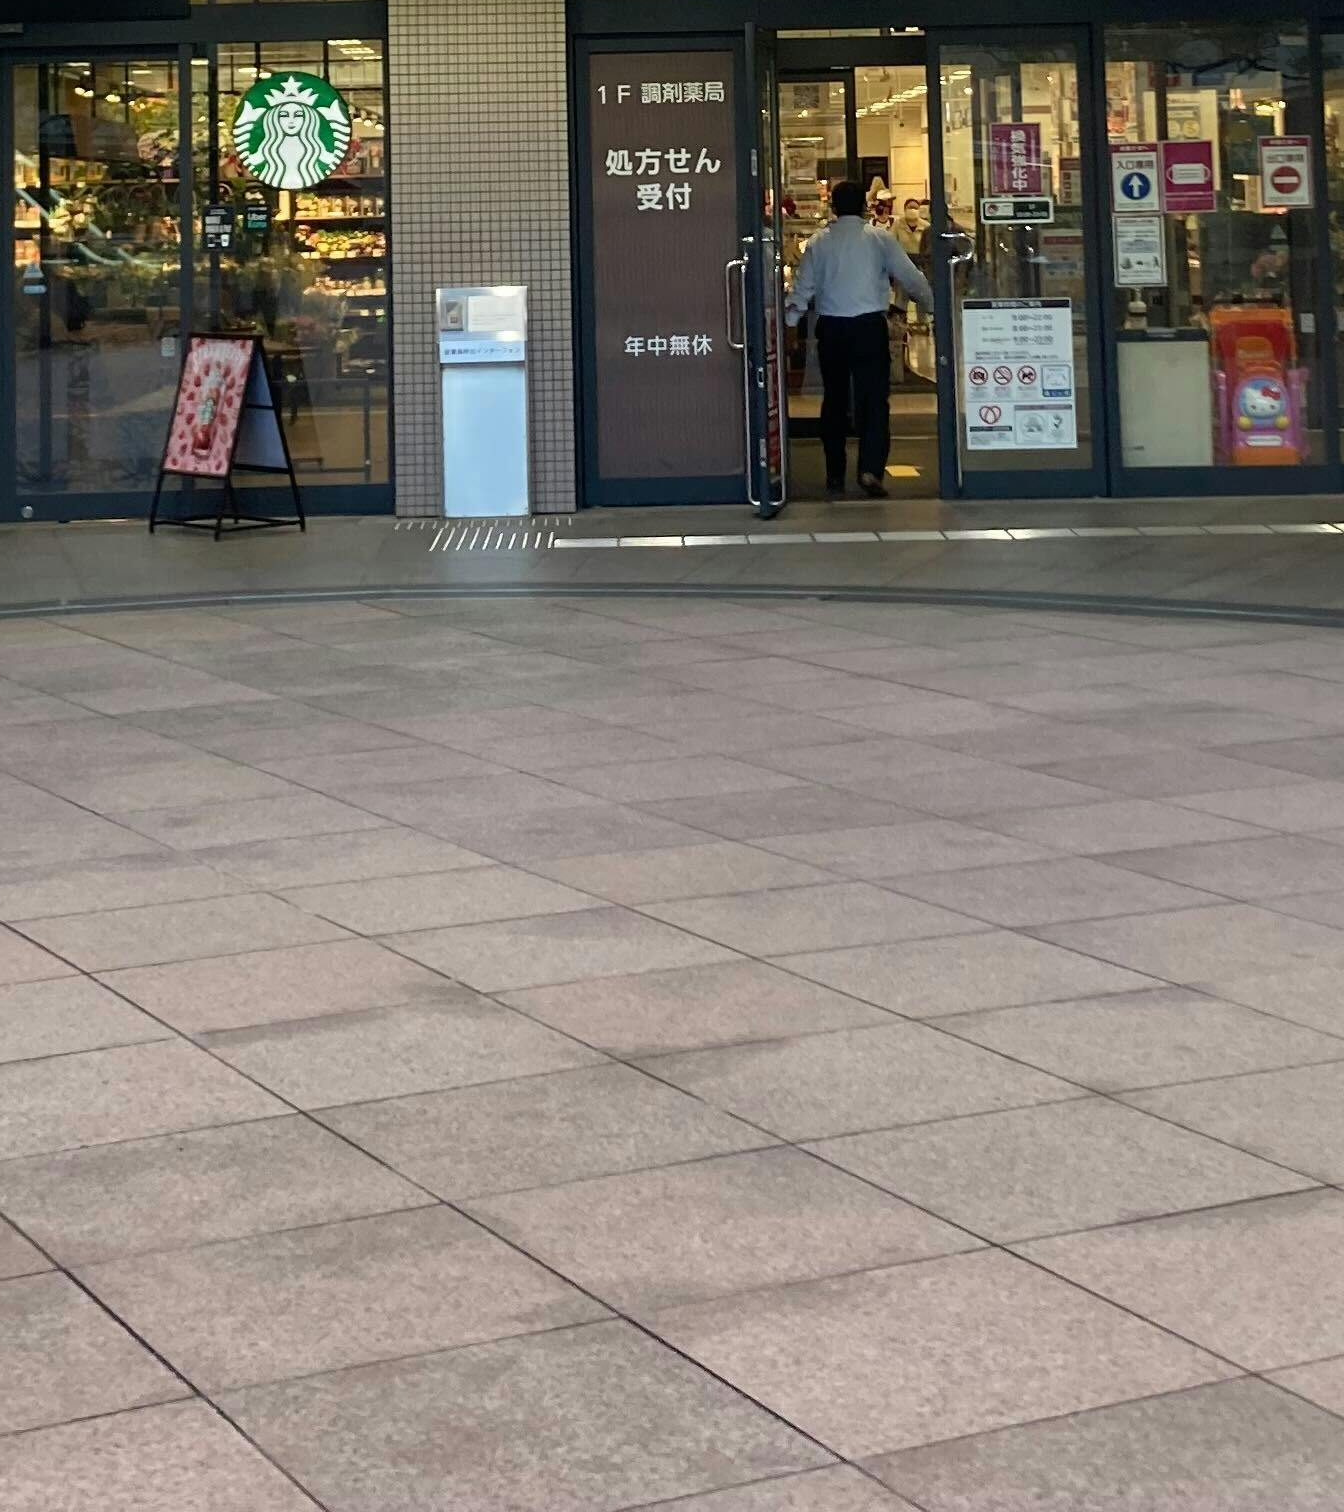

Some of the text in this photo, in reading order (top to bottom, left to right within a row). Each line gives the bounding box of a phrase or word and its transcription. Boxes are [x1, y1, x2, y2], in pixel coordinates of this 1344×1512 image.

[641, 82, 725, 104] 調剤薬局
[605, 148, 722, 176] 処方せん
[636, 183, 693, 211] 受付
[624, 334, 714, 357] 年中無休
